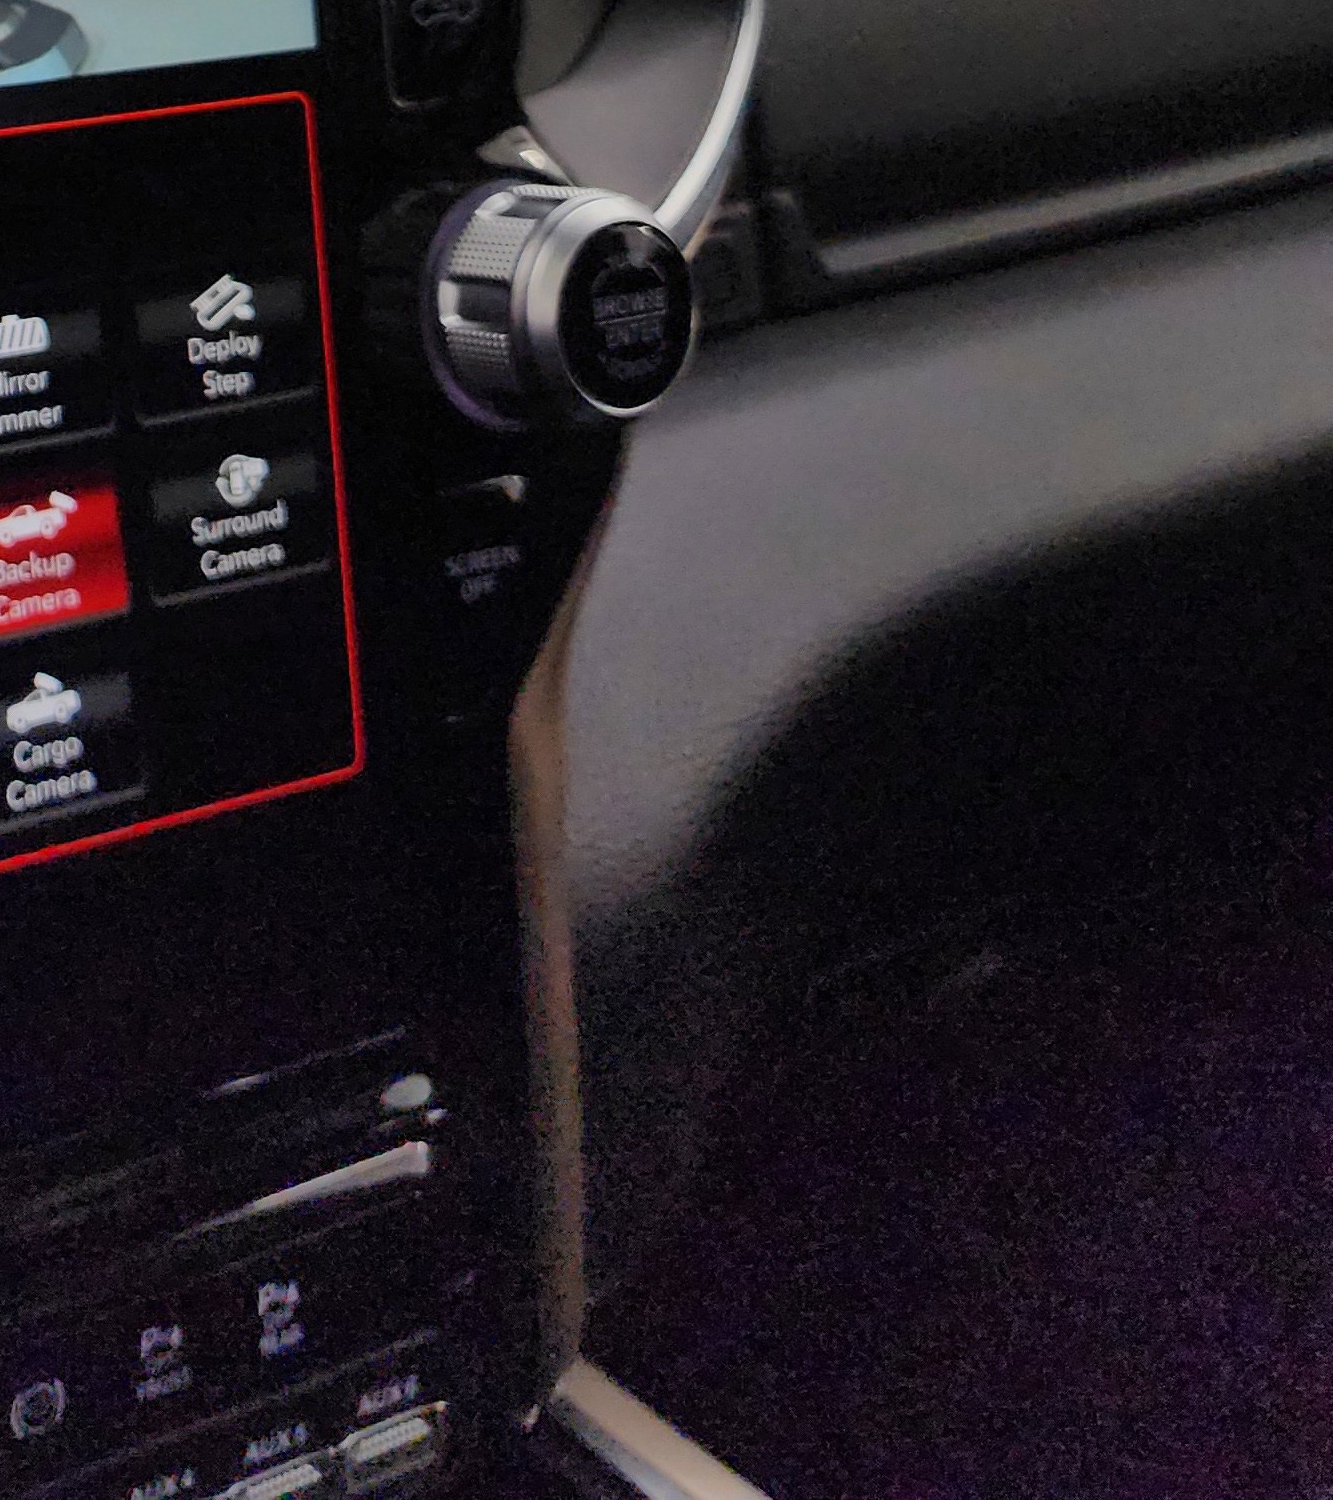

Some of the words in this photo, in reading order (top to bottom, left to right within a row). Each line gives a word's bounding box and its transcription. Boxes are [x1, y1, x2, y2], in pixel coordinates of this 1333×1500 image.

[188, 329, 262, 366] Deploy
[202, 369, 255, 400] Step
[191, 499, 289, 548] Surround
[200, 543, 285, 581] Camera
[13, 736, 84, 773] Cargo
[6, 770, 98, 812] Camera
